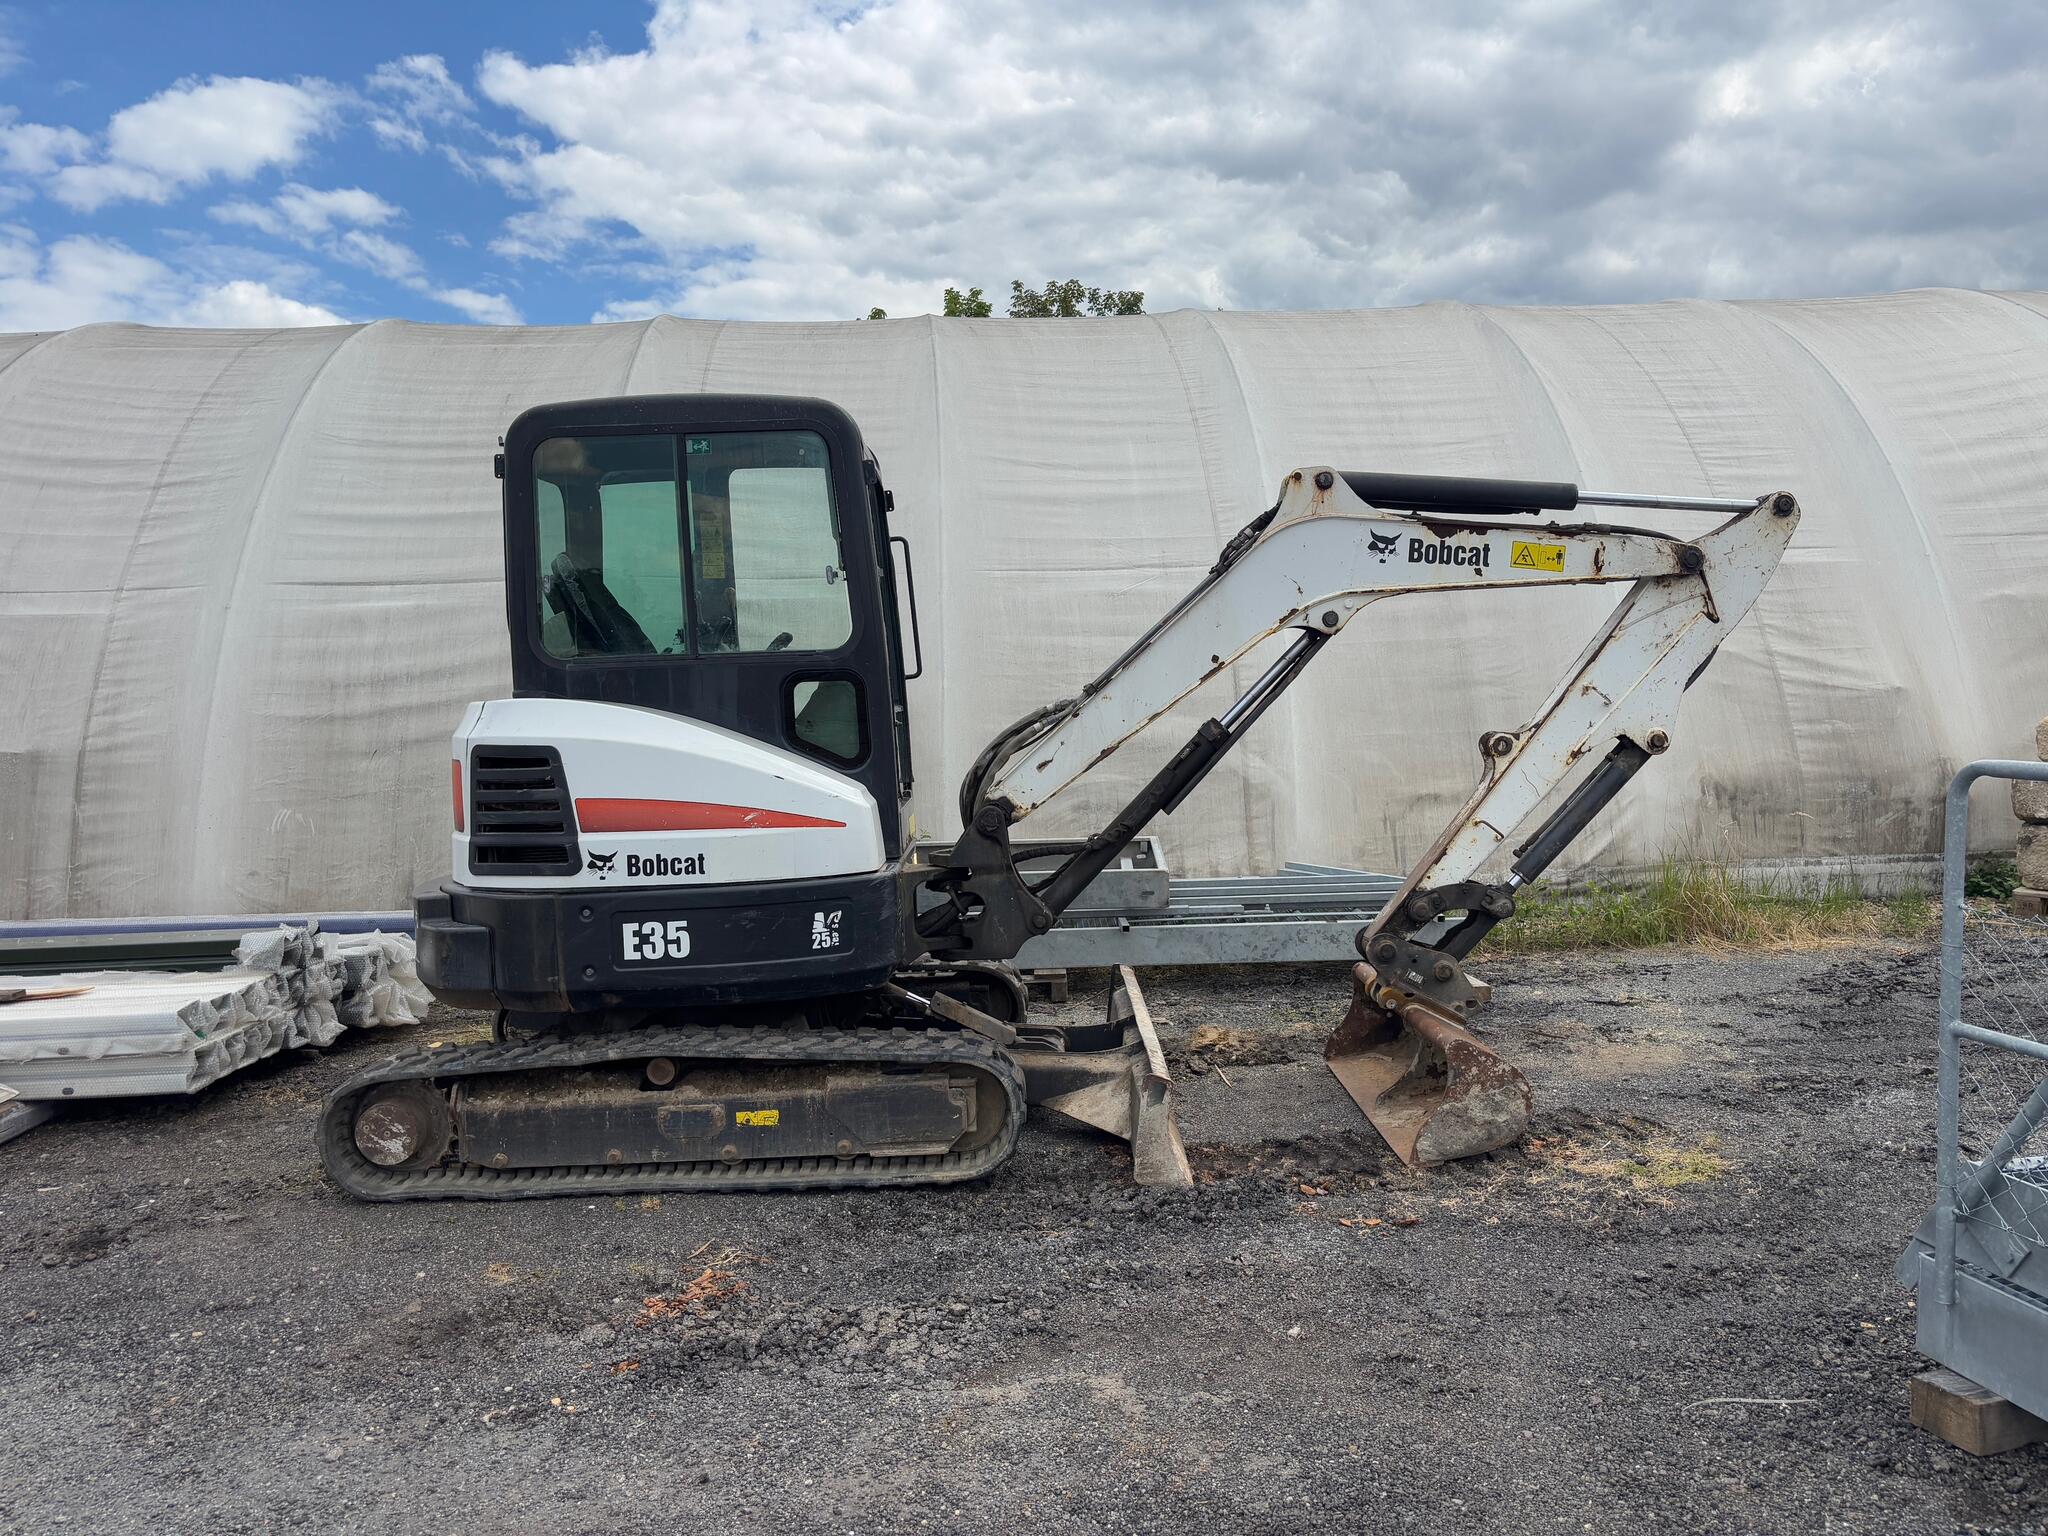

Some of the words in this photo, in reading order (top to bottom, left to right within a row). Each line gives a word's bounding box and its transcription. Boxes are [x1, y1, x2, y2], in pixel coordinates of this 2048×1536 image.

[1408, 538, 1491, 567] Bobcat
[626, 853, 705, 877] Bobcat
[622, 920, 691, 961] E35
[811, 932, 831, 949] 25
